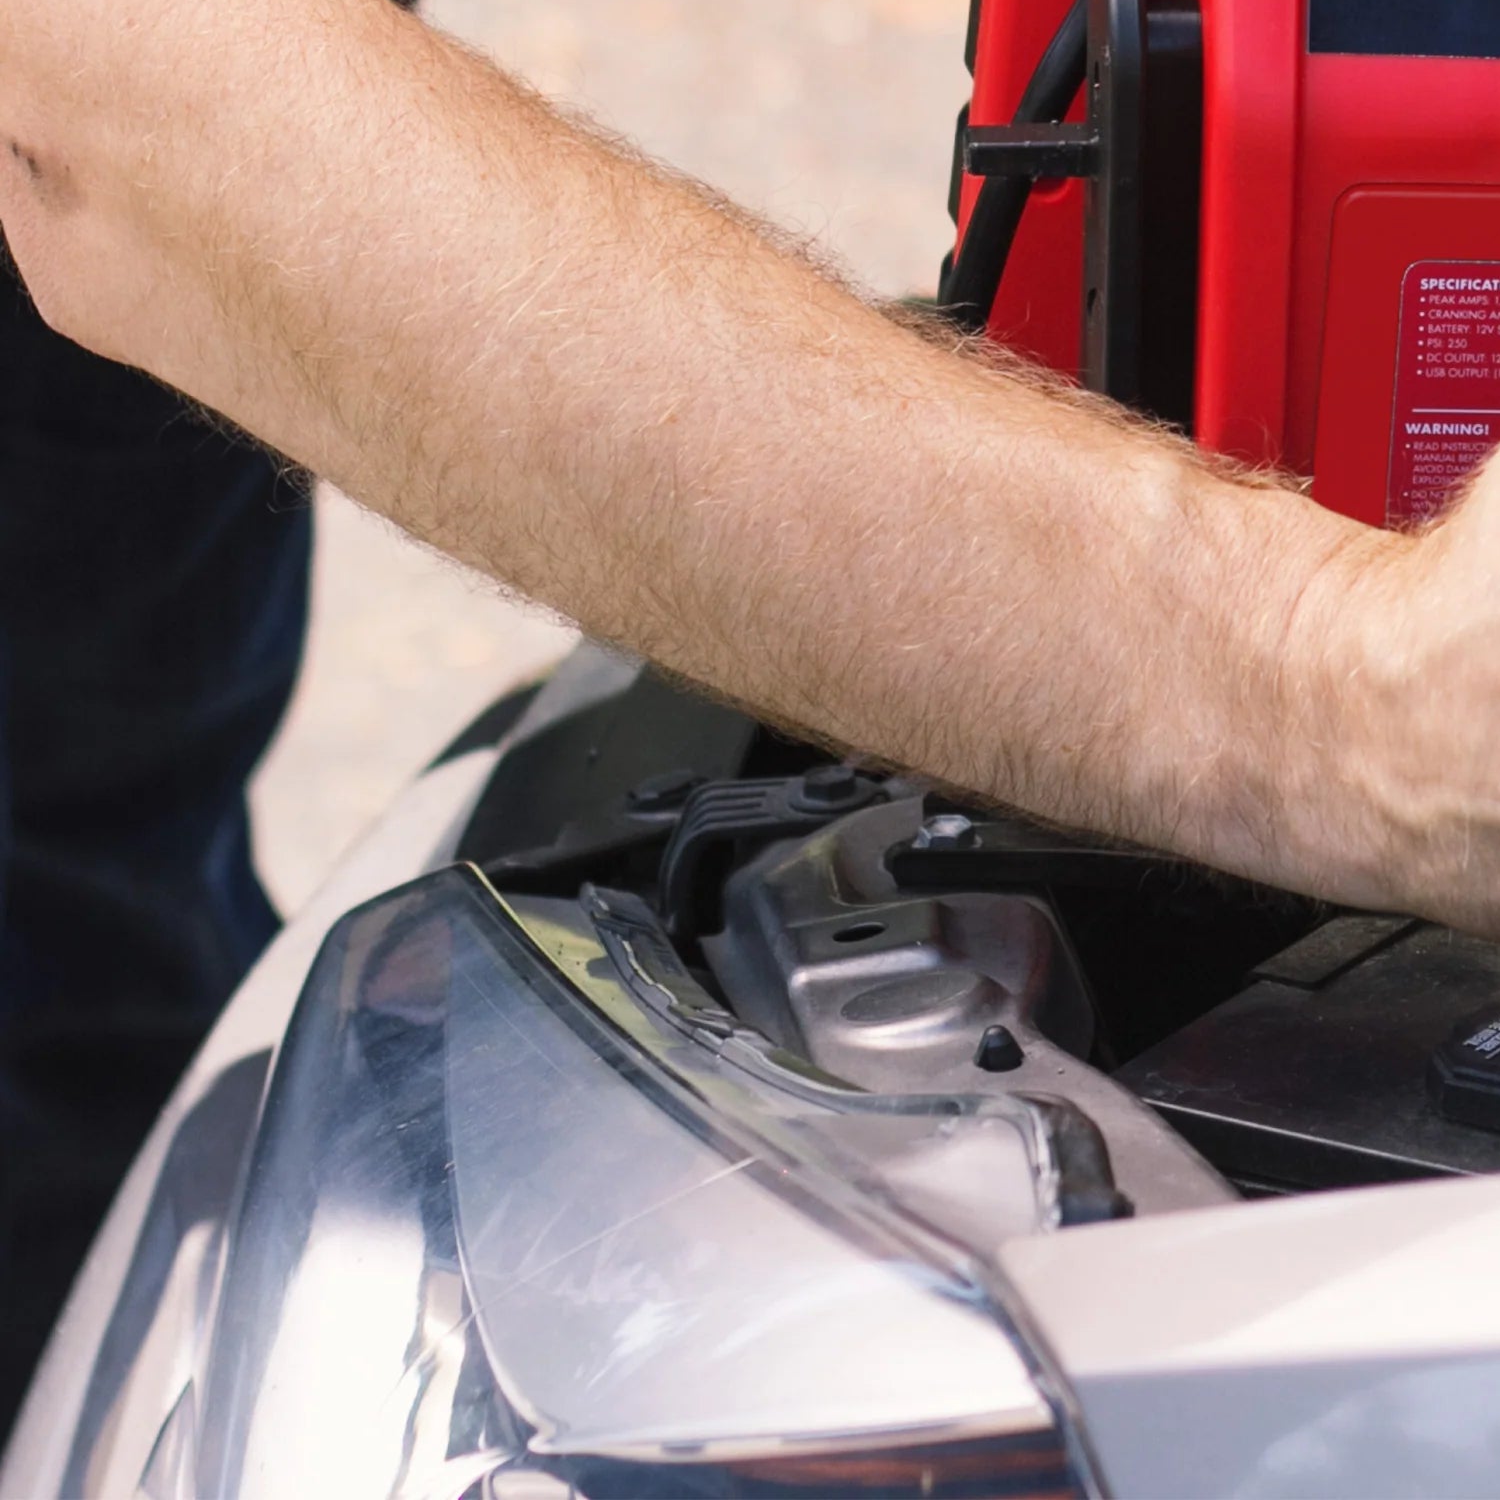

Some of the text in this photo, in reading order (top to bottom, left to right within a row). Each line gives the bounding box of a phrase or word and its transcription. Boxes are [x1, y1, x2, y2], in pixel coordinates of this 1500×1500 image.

[1428, 295, 1455, 305] PEAK
[1428, 310, 1486, 321] CRANKING
[1476, 324, 1495, 335] 12V
[1447, 339, 1468, 349] 250
[1426, 353, 1441, 363] DC
[1425, 367, 1445, 378] USB
[1405, 422, 1489, 436] WARNING!
[1412, 441, 1440, 452] READ
